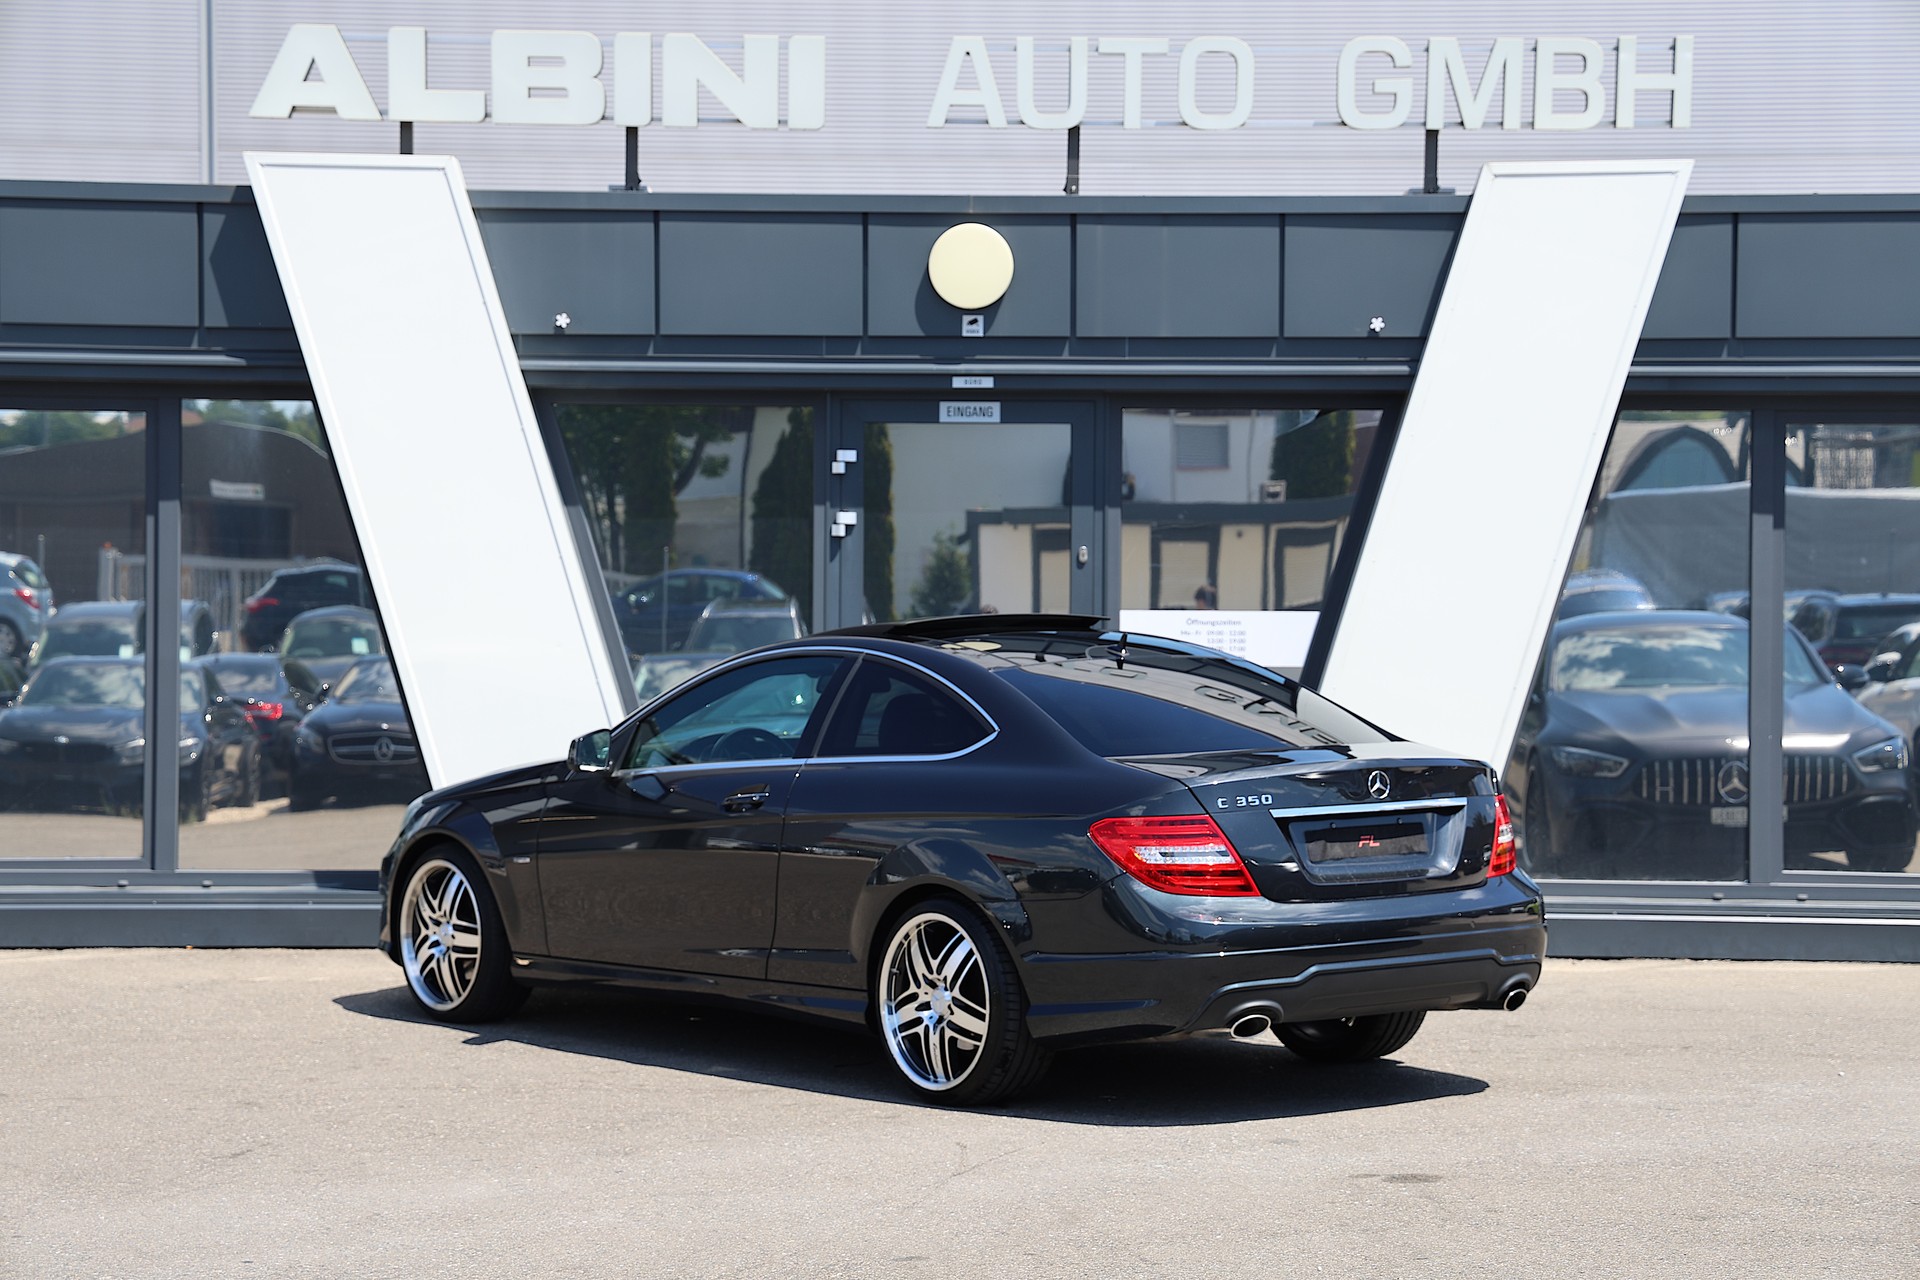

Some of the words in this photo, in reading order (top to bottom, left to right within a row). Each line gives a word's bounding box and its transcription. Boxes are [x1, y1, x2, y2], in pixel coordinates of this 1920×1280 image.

[248, 22, 826, 130] ALBINI
[926, 35, 1256, 131] AUTO
[1335, 34, 1695, 131] GMBH
[946, 405, 994, 417] EINGANG
[1186, 618, 1242, 626] Öffnungszeiten
[1217, 797, 1229, 809] C
[1235, 794, 1273, 807] 350
